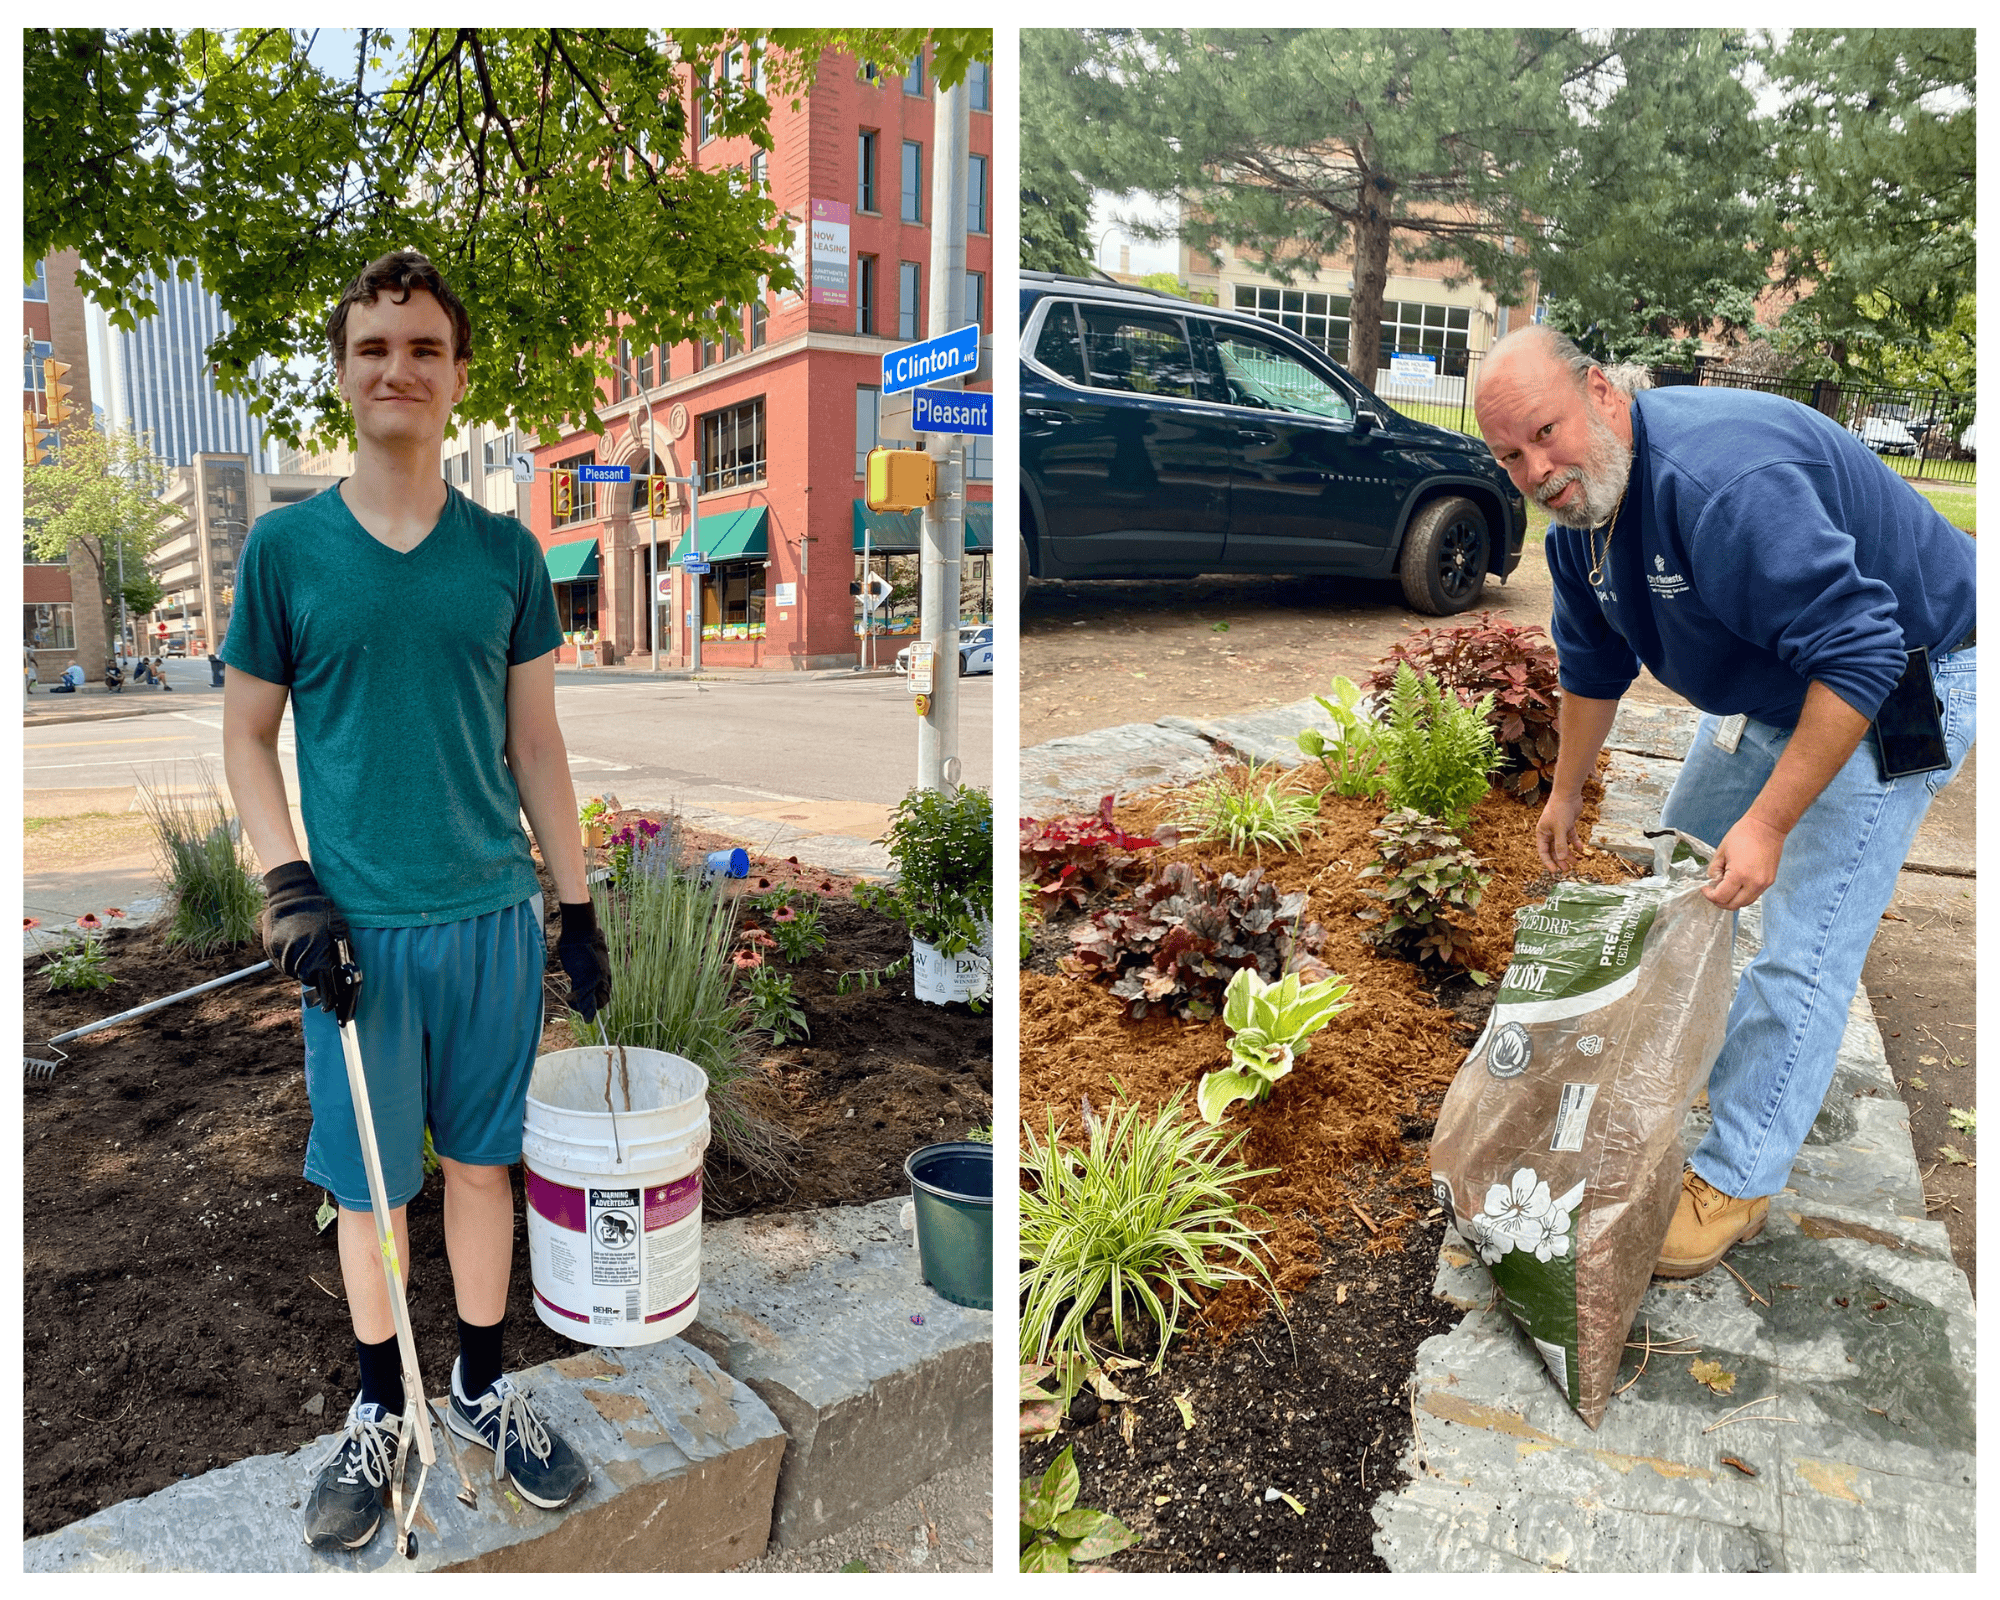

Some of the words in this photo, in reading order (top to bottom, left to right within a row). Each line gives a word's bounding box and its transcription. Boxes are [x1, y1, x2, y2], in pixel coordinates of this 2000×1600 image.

[813, 231, 835, 241] NOW
[813, 242, 847, 254] LEASING
[814, 267, 842, 278] APARTMENTS
[830, 276, 845, 284] SPACE
[885, 368, 893, 386] N
[896, 347, 960, 382] Clinton
[962, 351, 976, 363] AVE
[916, 397, 988, 427] Pleasant
[585, 467, 624, 480] Pleasant
[1320, 473, 1388, 484] TRAVERSE
[1600, 892, 1637, 967] PREMIUM
[1616, 931, 1635, 966] CEDAR
[1511, 1022, 1529, 1044] CONTROL
[1557, 1098, 1568, 1134] GUIDELINES
[600, 1190, 629, 1199] WARNING
[594, 1198, 635, 1207] ADVERTENCIA
[592, 1305, 613, 1314] BEHR
